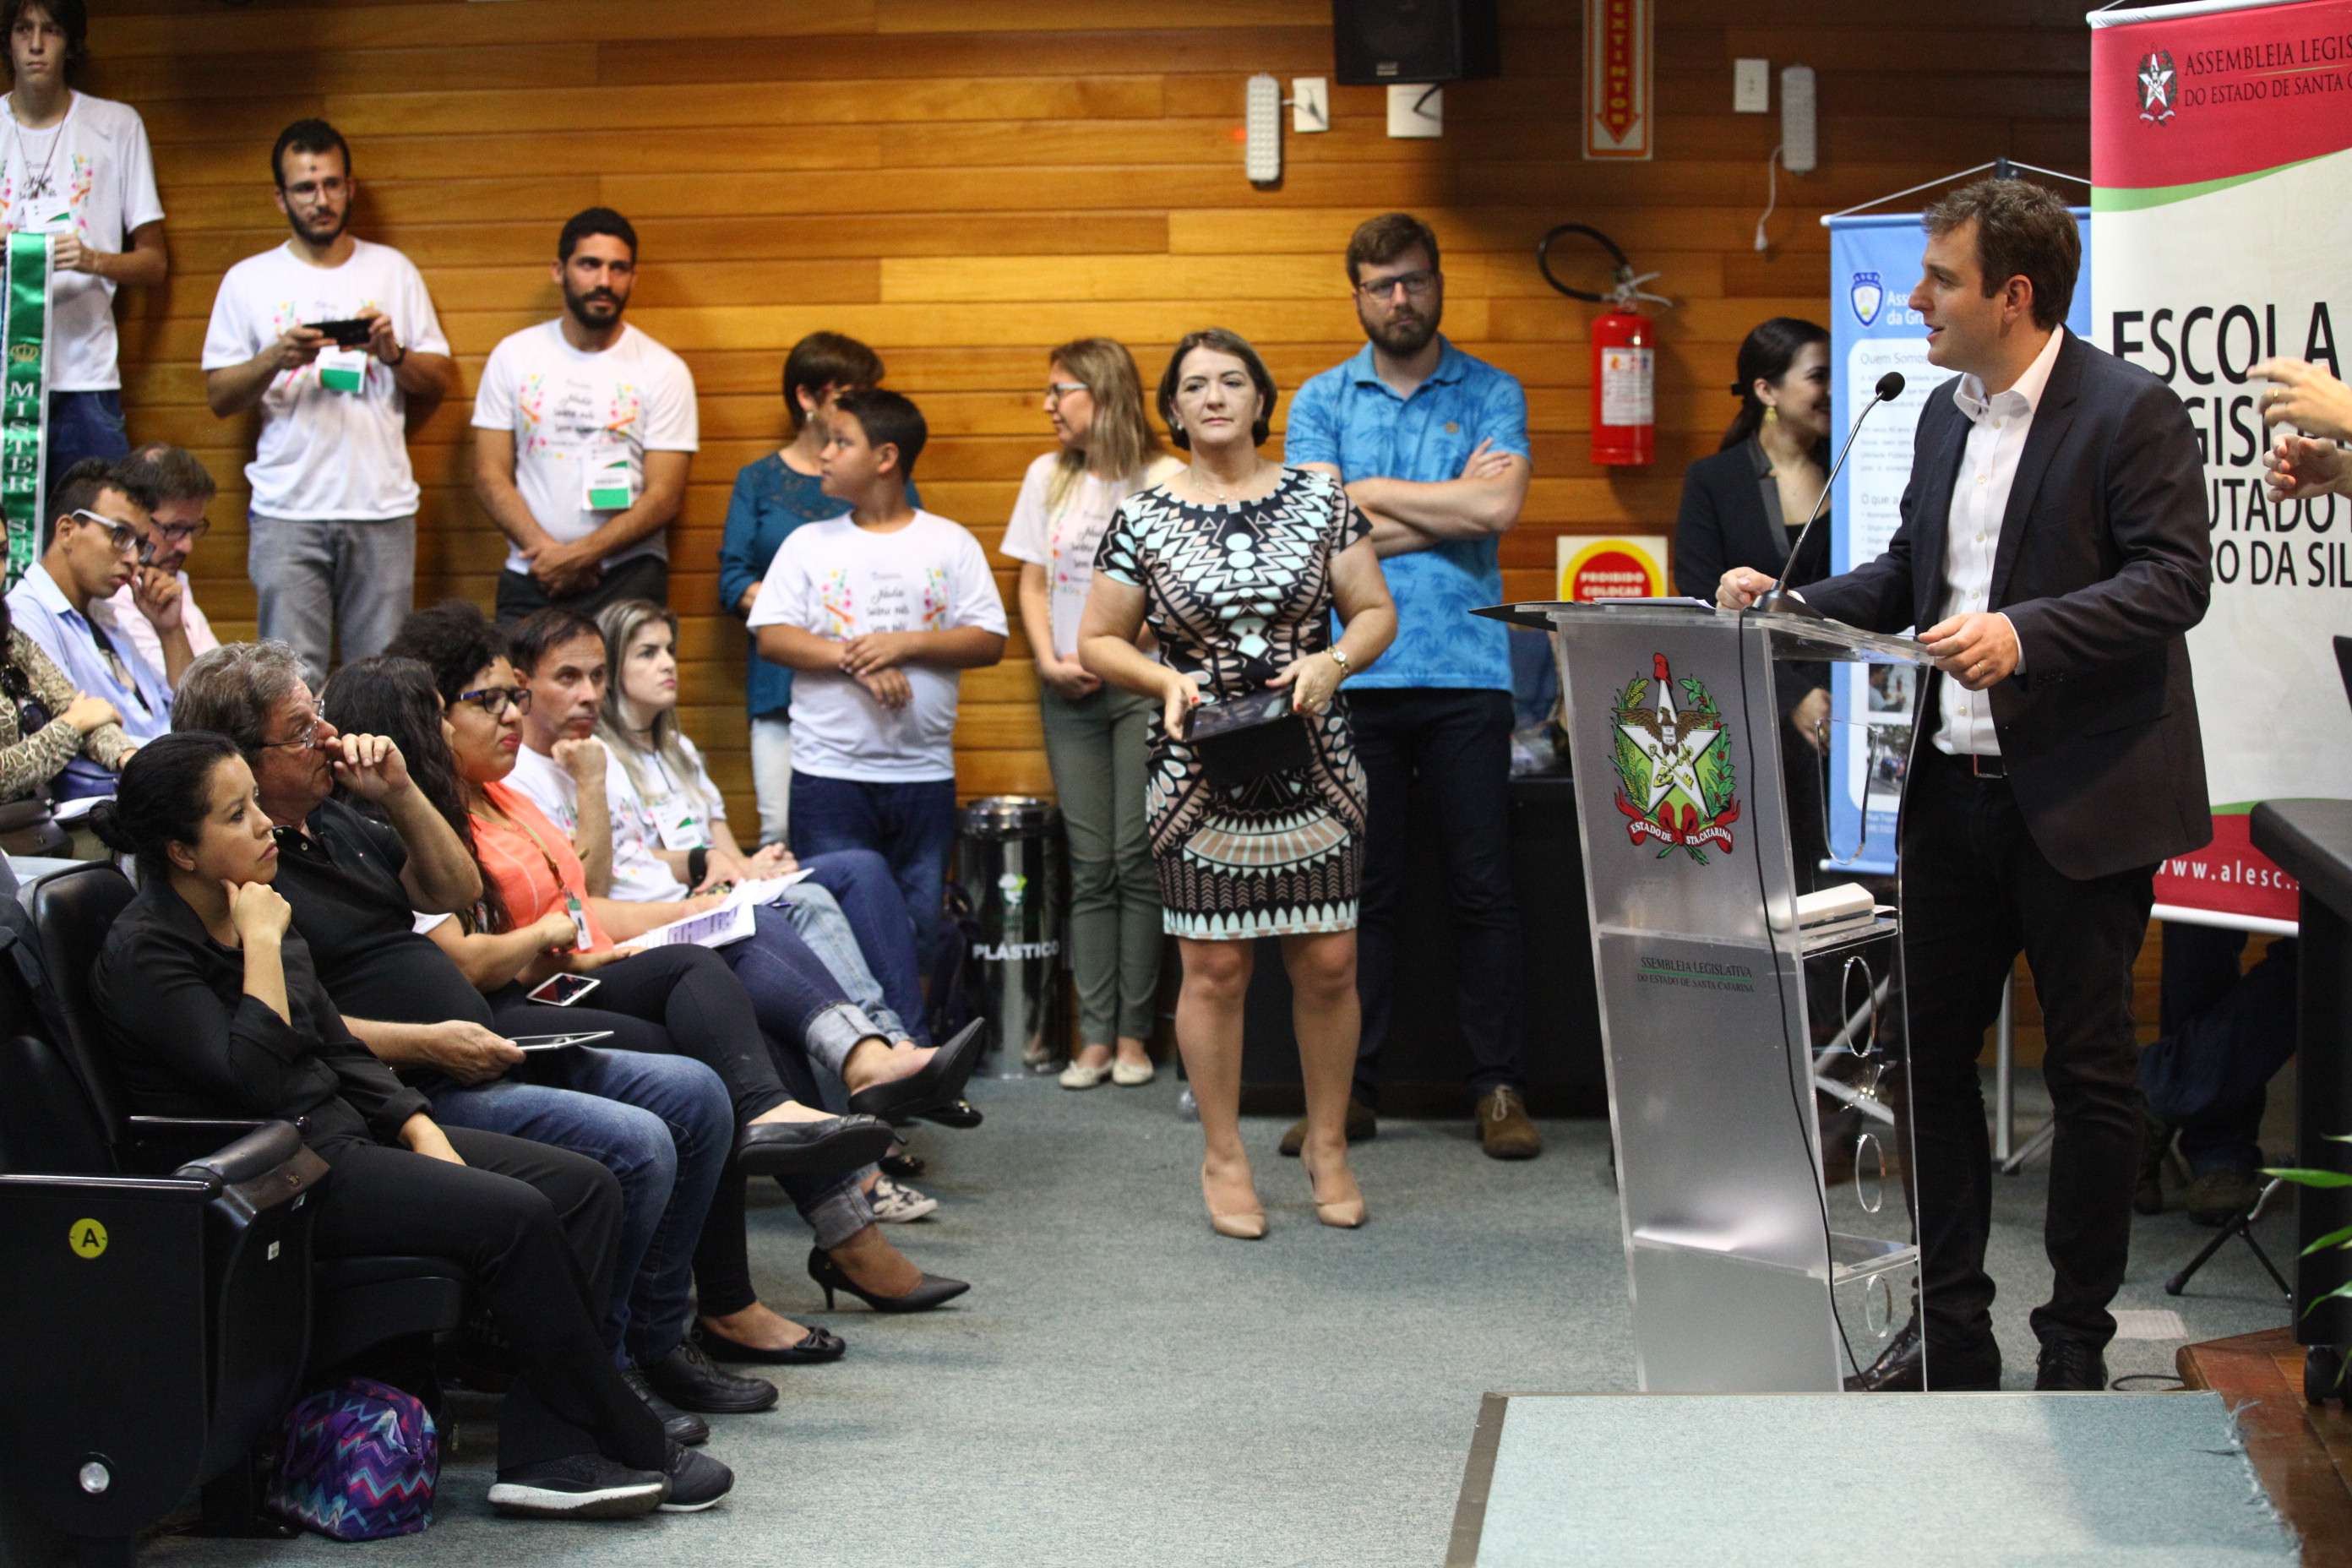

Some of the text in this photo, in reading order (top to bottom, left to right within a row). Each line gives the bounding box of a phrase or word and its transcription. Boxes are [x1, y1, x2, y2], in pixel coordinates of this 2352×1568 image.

[2185, 42, 2295, 76] ASSEMBLEIA
[2185, 88, 2206, 106] DO
[2211, 81, 2268, 104] ESTADO
[2273, 79, 2289, 98] DE
[2295, 74, 2344, 95] SANTA
[1886, 308, 1903, 325] da
[1860, 352, 1892, 365] Quem
[8, 381, 35, 493] MISTER
[2251, 540, 2297, 586] DA
[1631, 821, 1661, 837] ESTADO
[1661, 831, 1673, 842] DE
[1642, 956, 1752, 978] SSEMBLEIA LEGISLATIVA
[1637, 973, 1754, 993] DO ESTADO DE SANTA CATARINA
[82, 1228, 100, 1248] A
